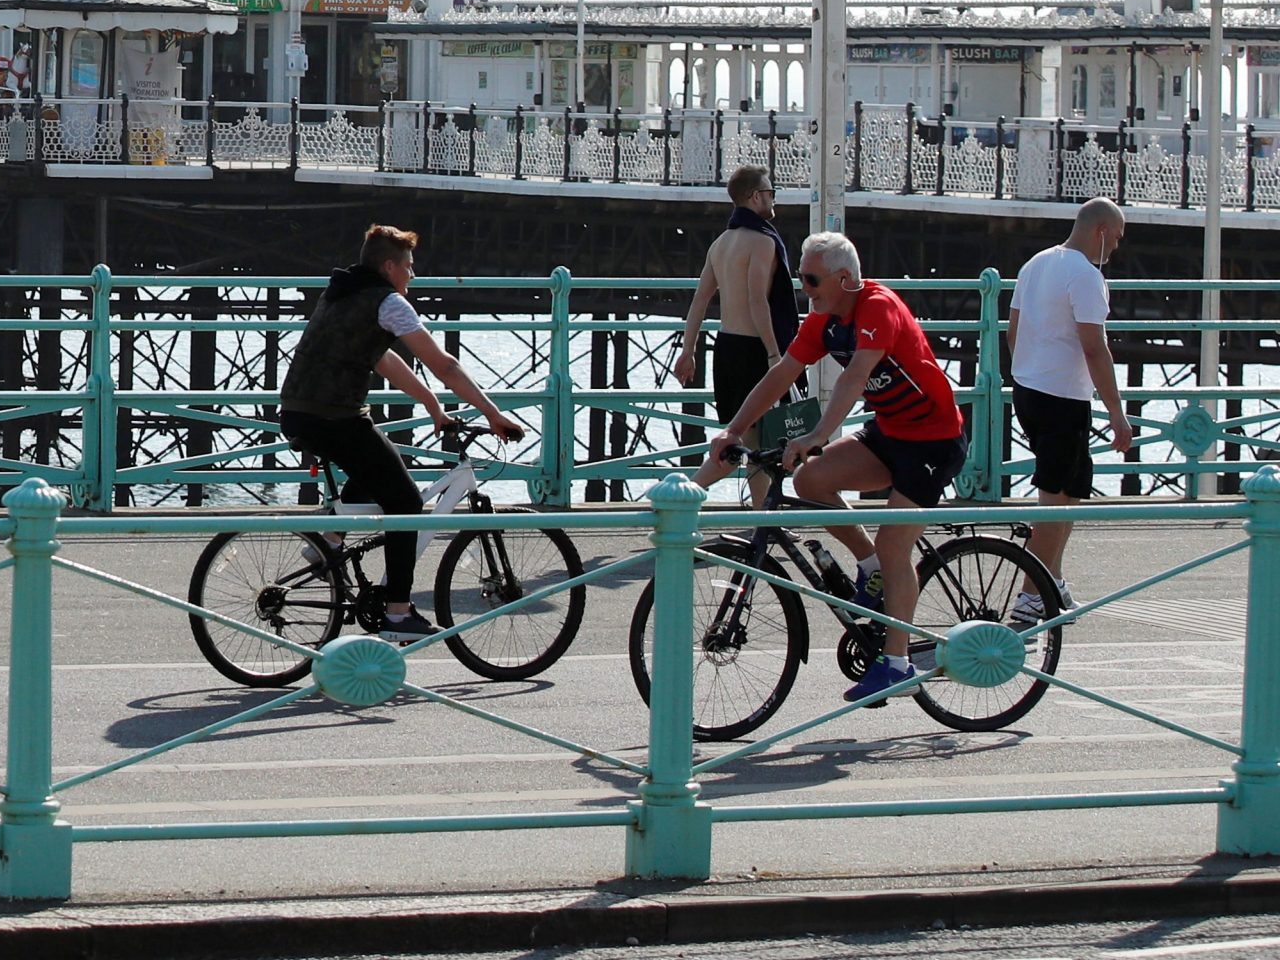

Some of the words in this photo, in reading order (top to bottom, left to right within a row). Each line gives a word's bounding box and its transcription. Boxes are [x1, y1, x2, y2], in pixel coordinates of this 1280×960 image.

[468, 43, 487, 55] COFFEE
[490, 45, 500, 56] ICE
[501, 41, 522, 54] CREAM
[852, 48, 873, 58] SLUSH
[874, 48, 888, 58] BAR
[951, 47, 991, 59] SLUSH
[994, 48, 1019, 59] BAR
[136, 81, 161, 89] VISITOR
[833, 144, 841, 156] 2
